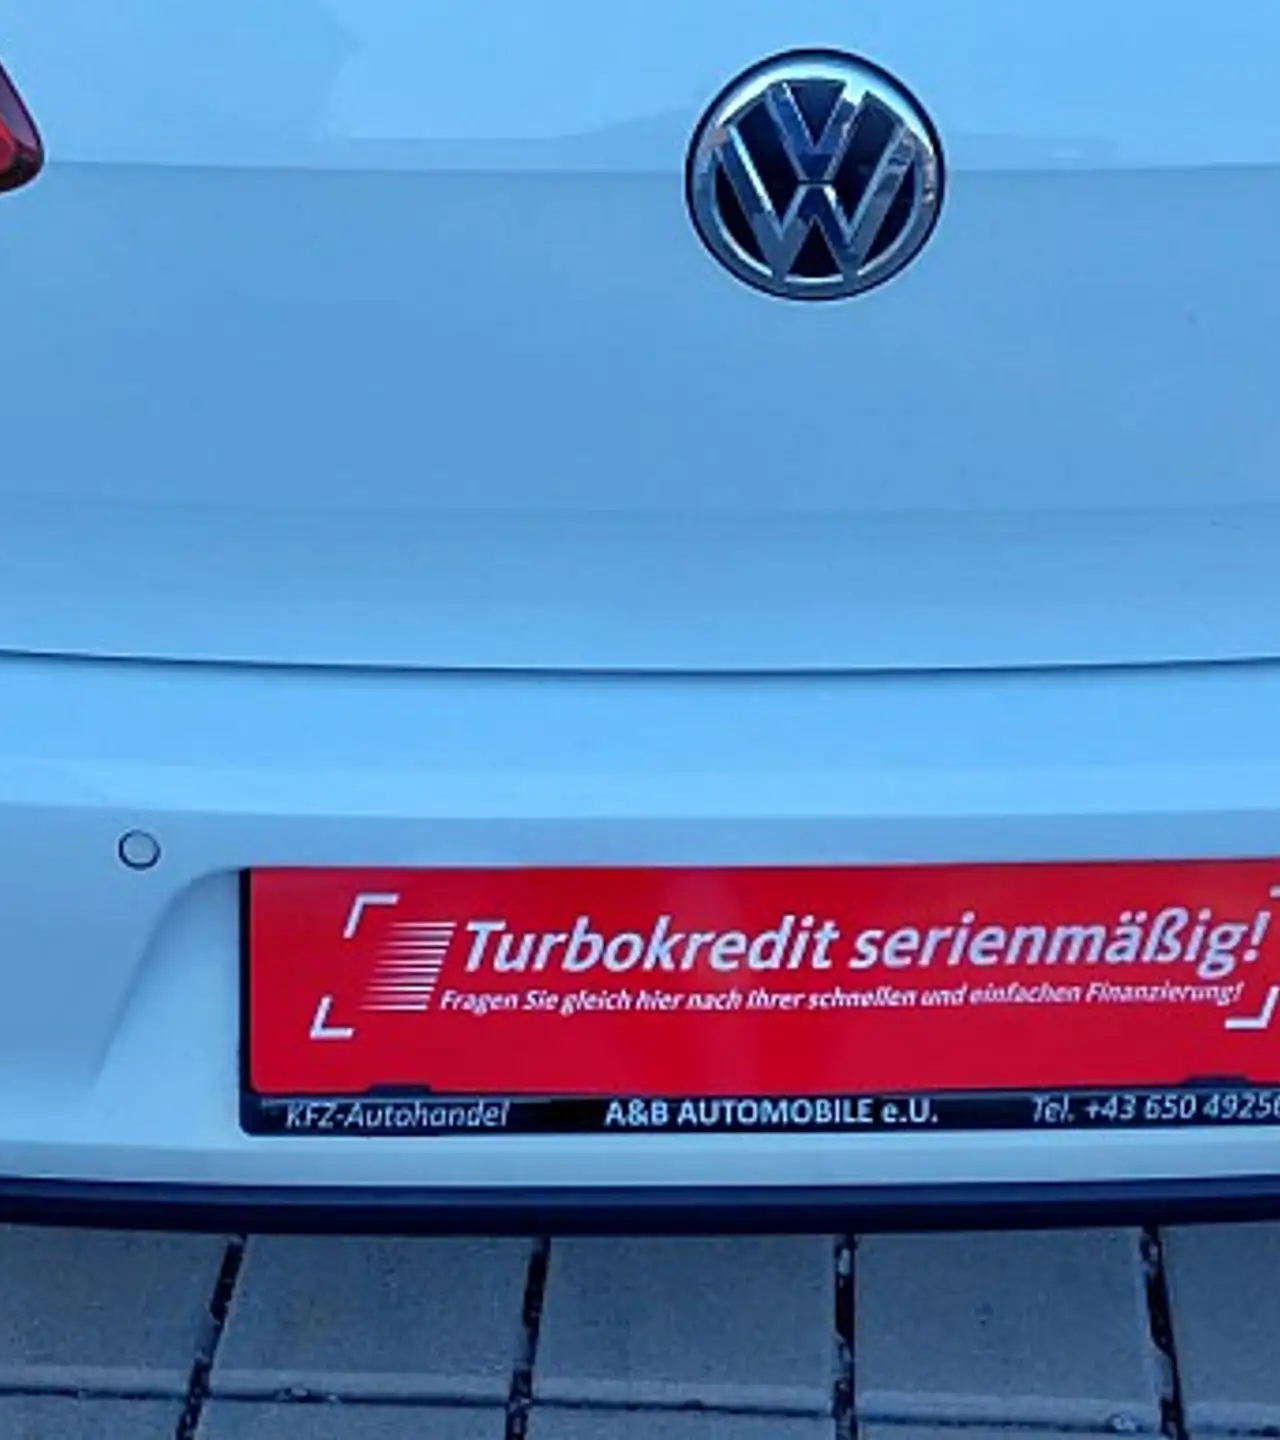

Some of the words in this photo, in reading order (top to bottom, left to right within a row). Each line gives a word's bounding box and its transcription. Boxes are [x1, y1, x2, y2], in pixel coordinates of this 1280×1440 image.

[711, 72, 922, 284] VW
[464, 913, 840, 973] Turbokredit
[848, 905, 1272, 981] serienmäßig!
[440, 989, 519, 1016] Fragen
[523, 989, 559, 1011] Sie
[561, 988, 632, 1016] gleich
[636, 988, 681, 1011] hier
[686, 988, 741, 1011] nach
[746, 987, 805, 1010] Ihrer
[807, 986, 918, 1010] schnellen
[921, 985, 966, 1007] und
[969, 982, 1081, 1007] einfachen
[1084, 980, 1245, 1009] Finanzierung!
[285, 1099, 511, 1129] KFZ-Autohandel
[604, 1099, 669, 1125] A&B
[677, 1098, 874, 1125] AUTOMOBILE
[880, 1098, 939, 1125] e.U.
[1031, 1096, 1076, 1123] Tel.
[1084, 1096, 1136, 1122] +43
[1144, 1095, 1198, 1121] 650
